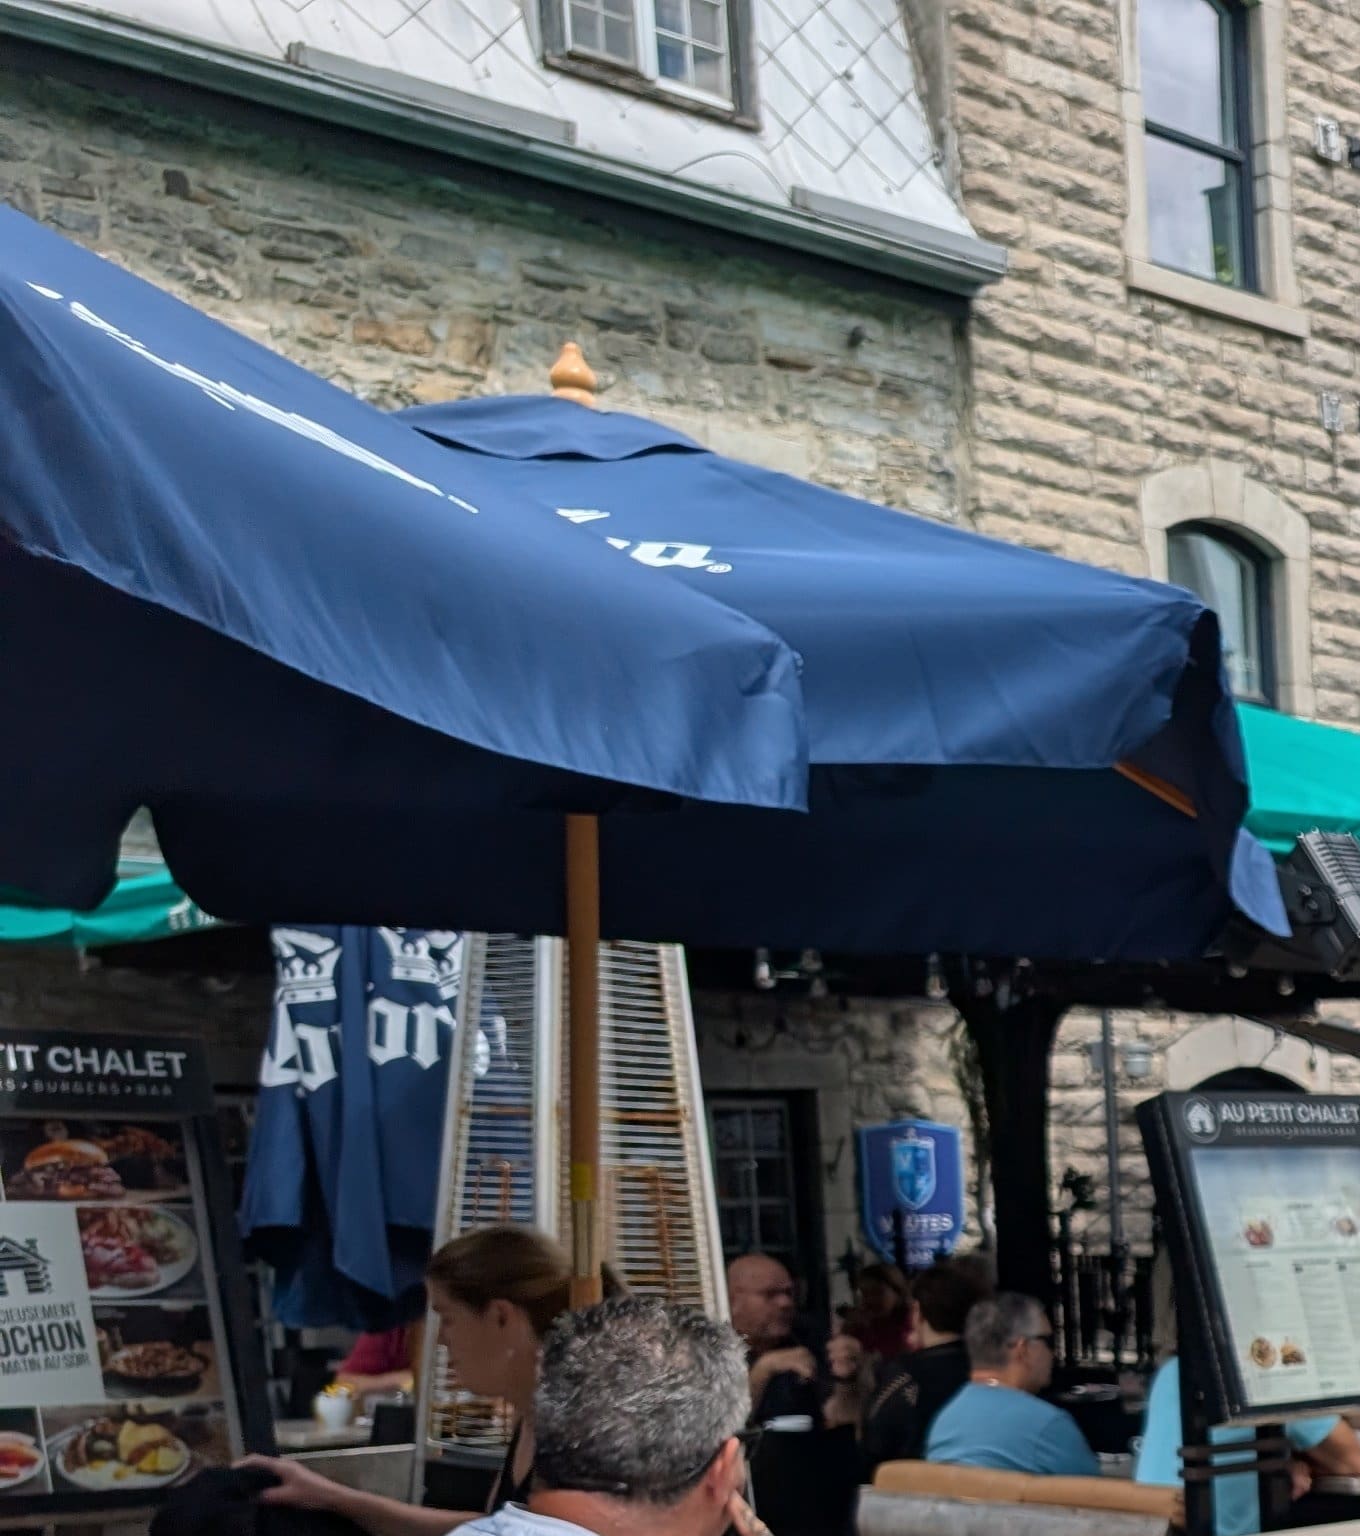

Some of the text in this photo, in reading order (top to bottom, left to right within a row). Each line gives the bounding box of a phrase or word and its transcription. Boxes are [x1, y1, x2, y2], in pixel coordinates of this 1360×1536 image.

[0, 1042, 187, 1078] IT CHALET
[1220, 1102, 1360, 1124] AU PETIT CHALET
